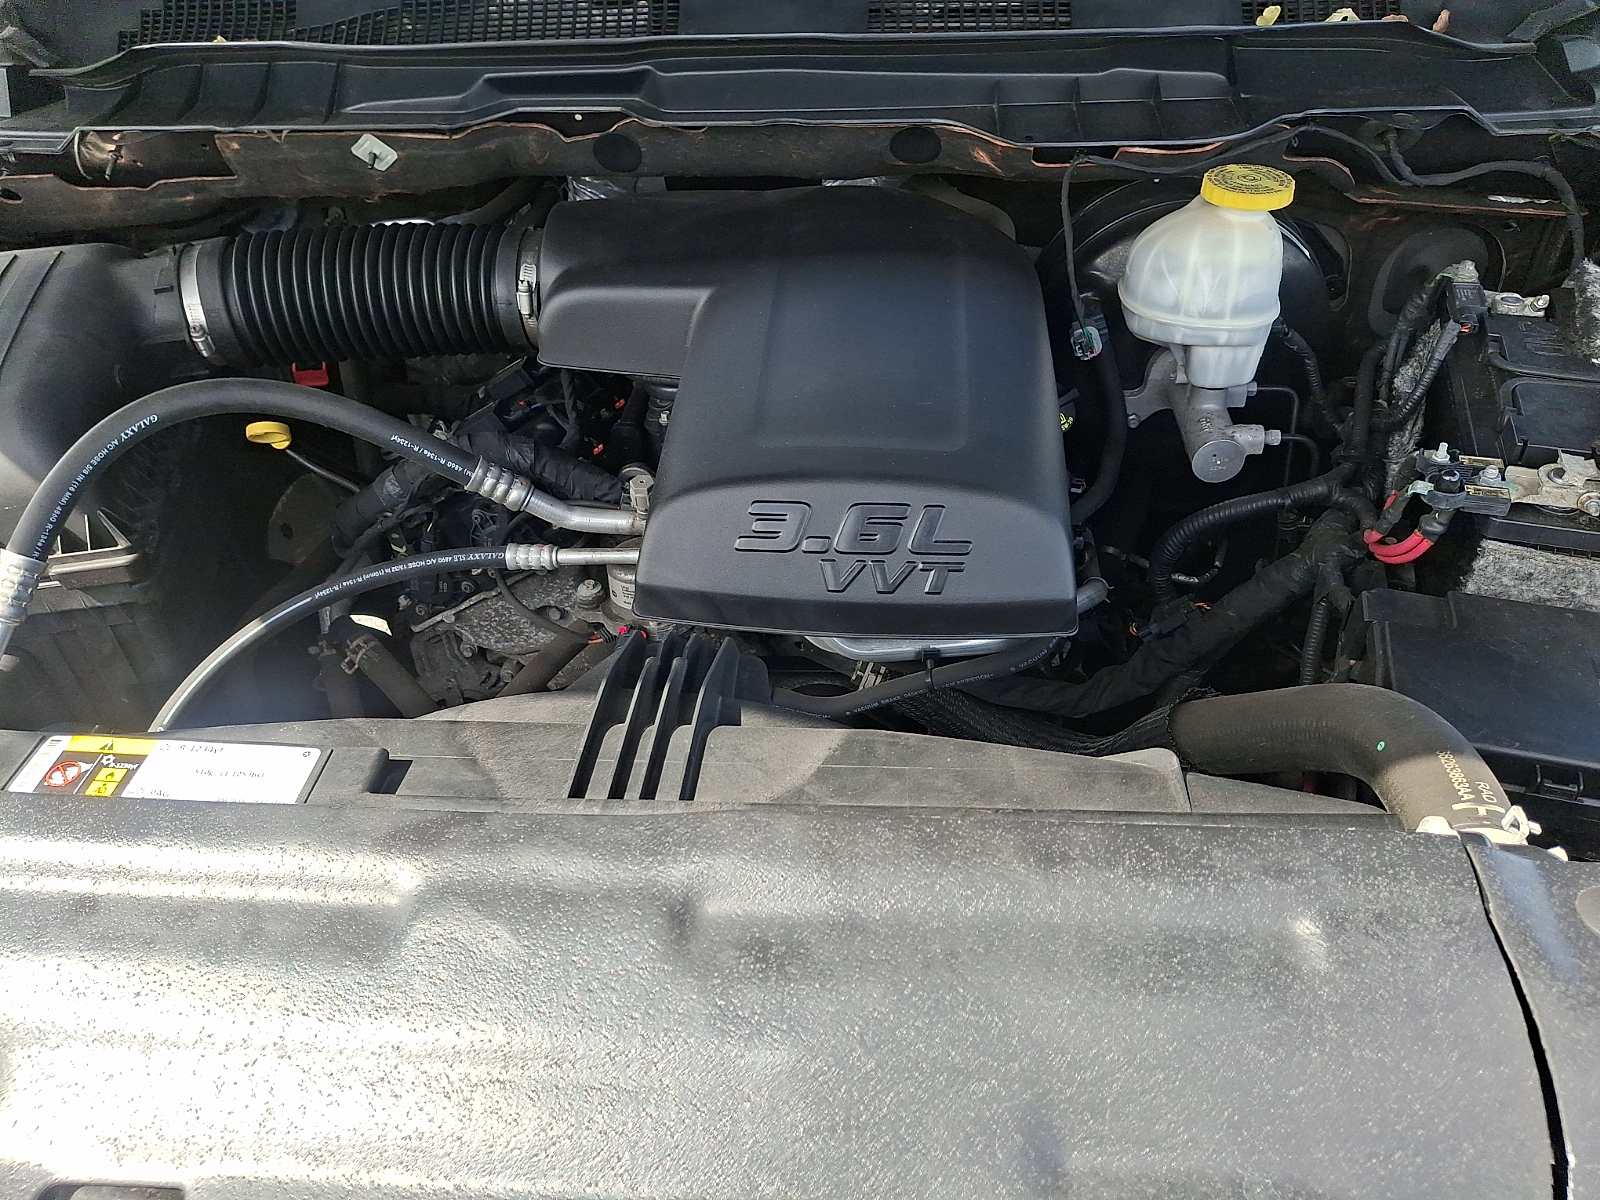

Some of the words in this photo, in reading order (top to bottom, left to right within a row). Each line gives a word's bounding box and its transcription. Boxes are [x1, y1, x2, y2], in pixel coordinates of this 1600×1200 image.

[119, 414, 158, 441] GALAXY
[106, 438, 119, 450] A/C
[390, 434, 420, 452] R-1234yf
[90, 445, 108, 466] HOSE
[423, 449, 446, 464] R-134a
[82, 463, 93, 475] 5/8
[446, 461, 463, 472] 4860
[75, 471, 85, 483] IN
[48, 504, 62, 524] 4860
[734, 499, 973, 556] 3.6L
[425, 557, 437, 567] A/C
[437, 556, 452, 564] 4890
[453, 553, 466, 563] SLE
[468, 551, 505, 561] GALAXY
[407, 560, 425, 569] HOSE
[818, 558, 966, 595] VVT
[314, 585, 339, 598] R-1234yf
[1018, 649, 1049, 668] VACUUM
[852, 701, 879, 713] VACUUM
[880, 695, 903, 705] BRAKE
[1474, 781, 1498, 803] RAD
